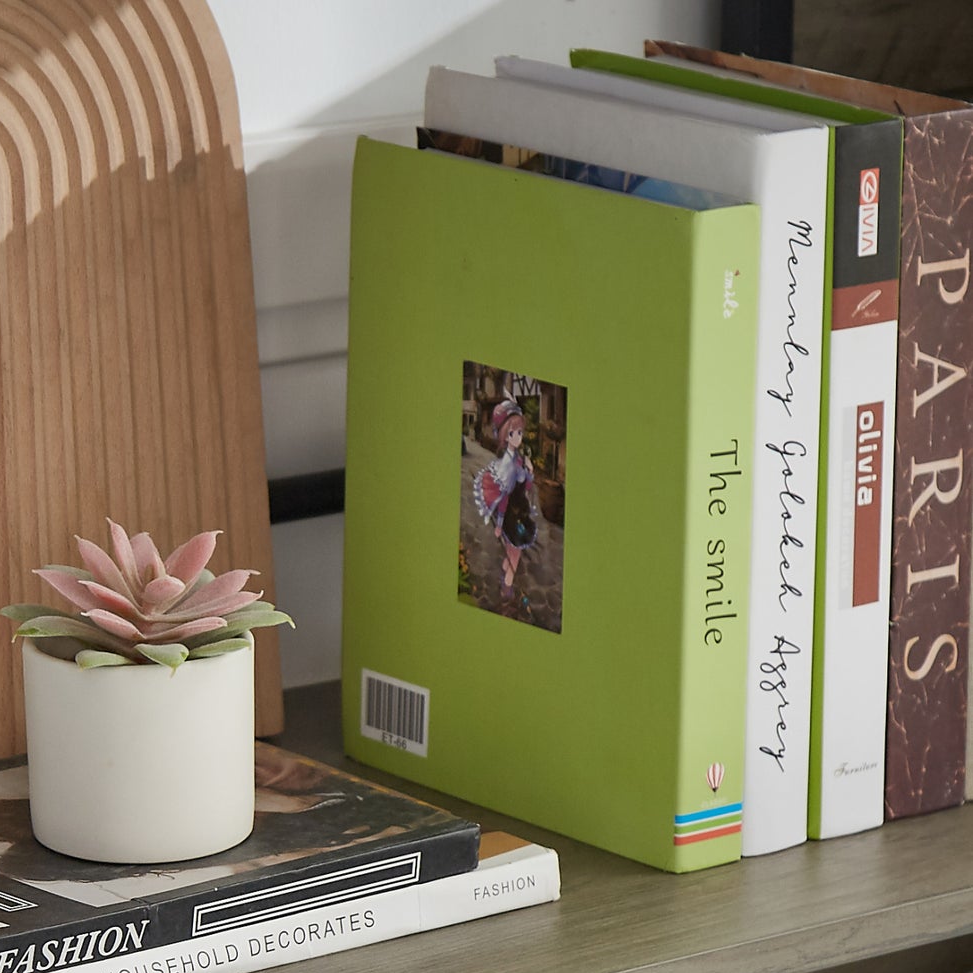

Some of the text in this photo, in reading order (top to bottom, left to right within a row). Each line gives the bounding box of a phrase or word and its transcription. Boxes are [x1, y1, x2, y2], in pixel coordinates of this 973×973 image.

[857, 410, 881, 506] olivia
[903, 247, 971, 681] PARIS
[704, 438, 742, 646] The smile
[248, 909, 376, 957] DECORATES
[473, 874, 537, 901] FASHION
